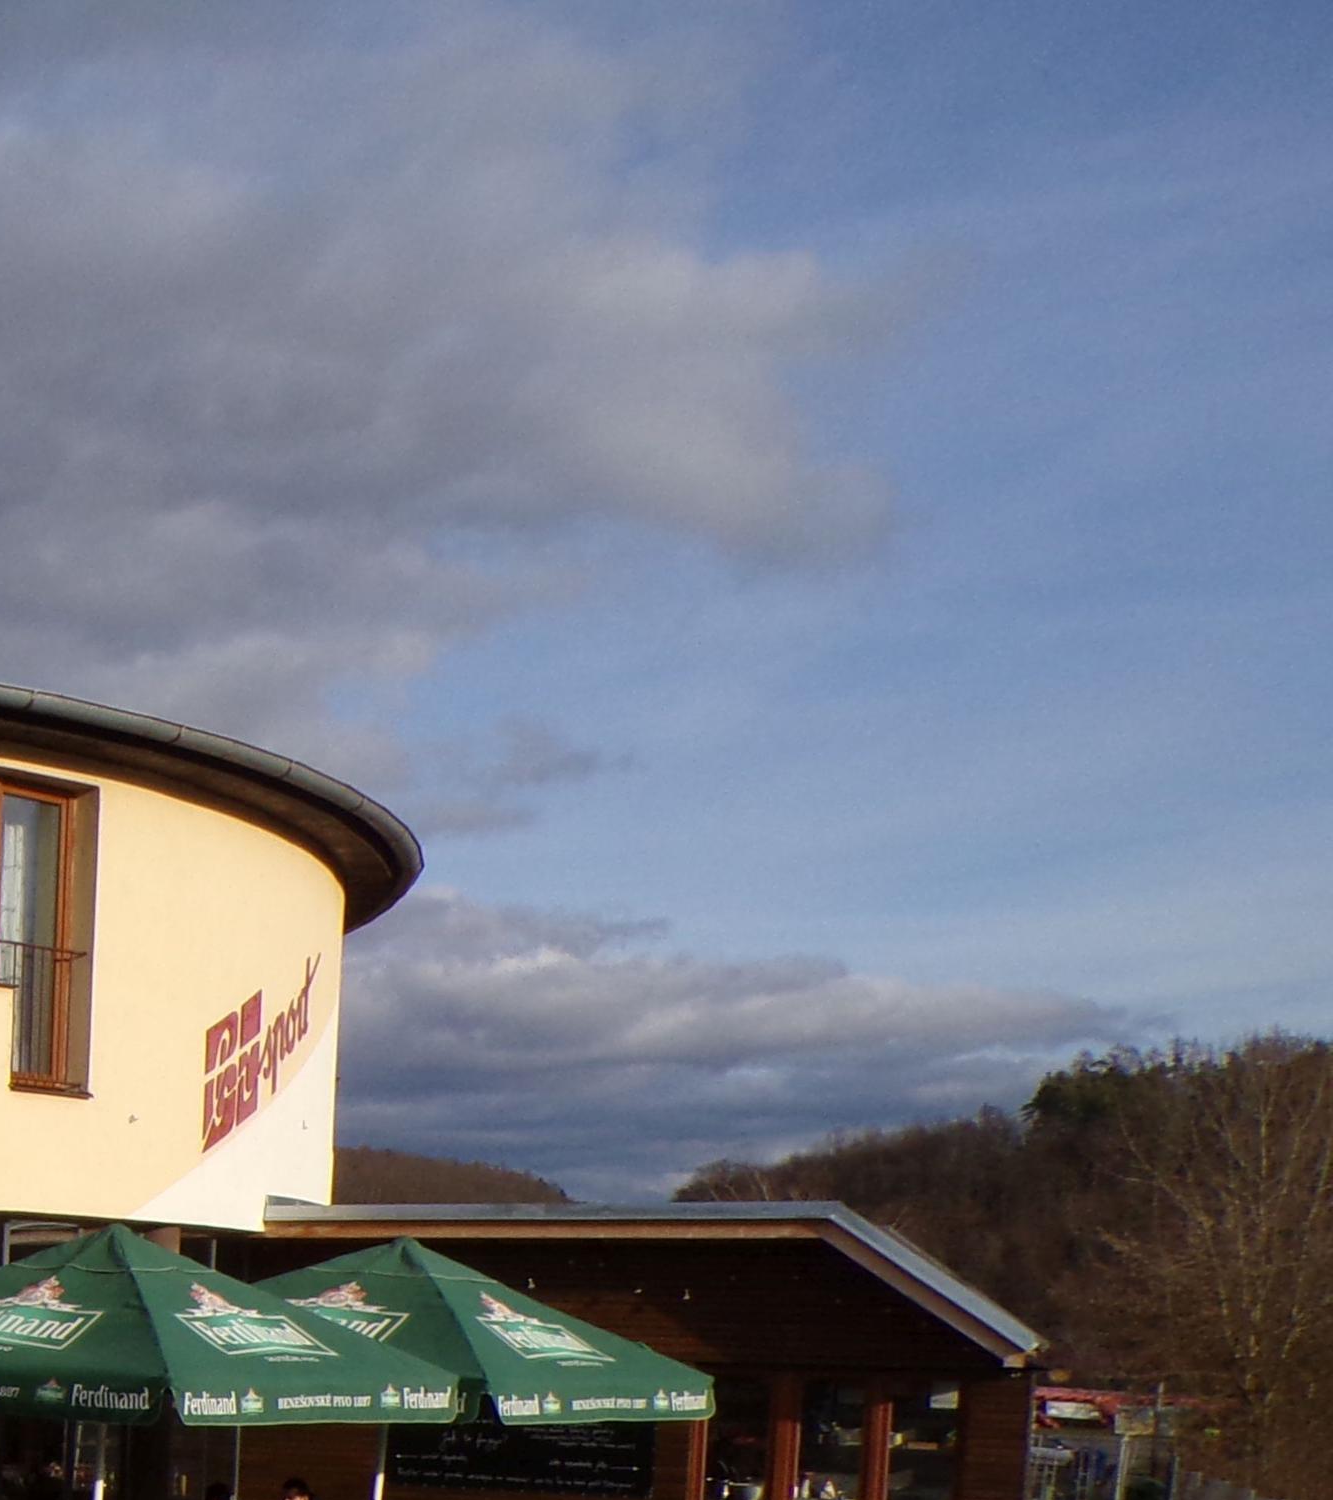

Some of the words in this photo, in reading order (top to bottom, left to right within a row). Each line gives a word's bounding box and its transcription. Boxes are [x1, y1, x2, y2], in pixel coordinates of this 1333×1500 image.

[70, 1383, 151, 1411] Ferdinand
[183, 1390, 237, 1417] Ferdinand
[402, 1385, 452, 1409] Ferdinand
